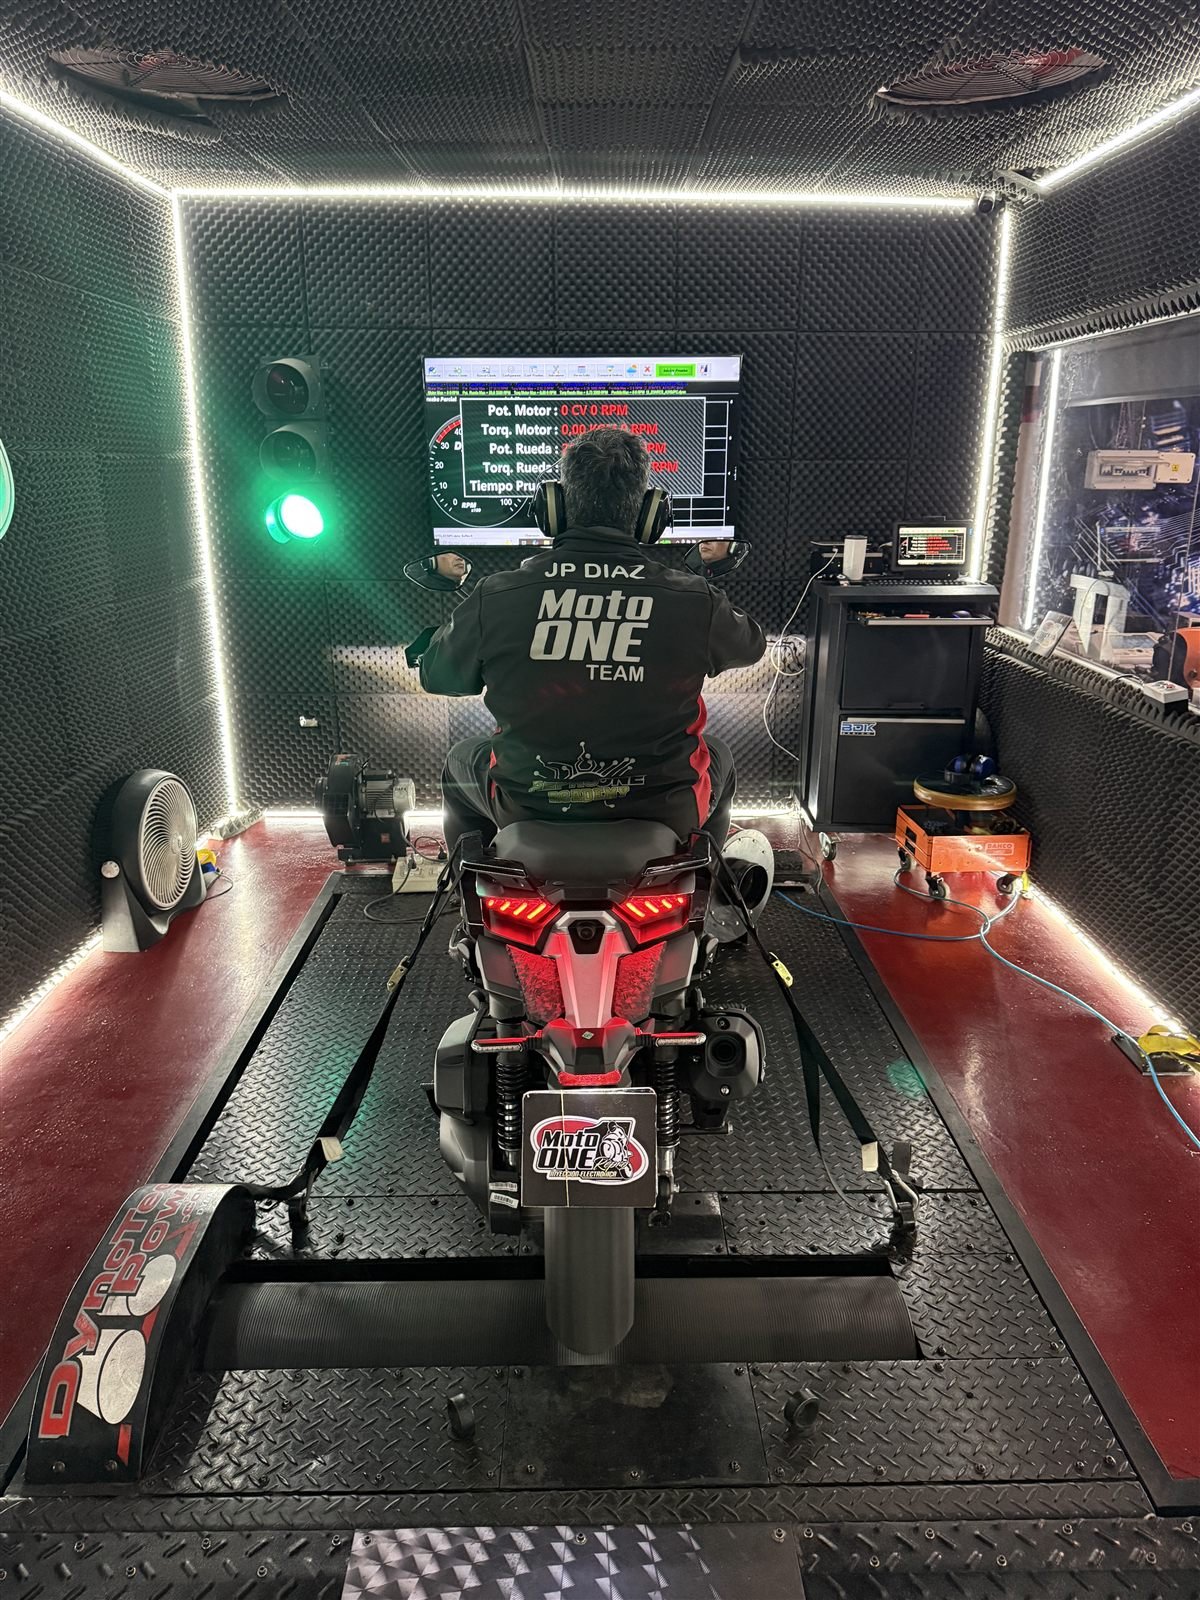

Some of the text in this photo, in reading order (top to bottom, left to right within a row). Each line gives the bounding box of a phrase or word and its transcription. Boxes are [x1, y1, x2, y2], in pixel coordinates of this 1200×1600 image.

[487, 404, 512, 416] Pot.
[561, 404, 568, 416] 0
[571, 404, 588, 416] CV
[590, 404, 598, 416] 0
[601, 404, 629, 416] RPM
[481, 423, 512, 438] Torq.
[561, 423, 586, 437] 0,00
[630, 423, 658, 435] RPM
[440, 442, 450, 450] 30
[489, 442, 513, 455] Pot.
[644, 442, 667, 453] PM
[434, 461, 444, 469] 20
[482, 461, 513, 476] Torq.
[650, 461, 679, 472] RPM
[469, 480, 536, 494] Tiempo Pru
[452, 498, 458, 506] 0
[499, 498, 513, 506] 100
[544, 562, 646, 580] JP DIAZ
[537, 588, 654, 621] Moto
[529, 620, 649, 662] ONE
[585, 664, 645, 683] TEAM
[541, 1130, 601, 1147] Moto
[537, 1148, 598, 1170] ONE
[108, 1184, 198, 1293] Pow
